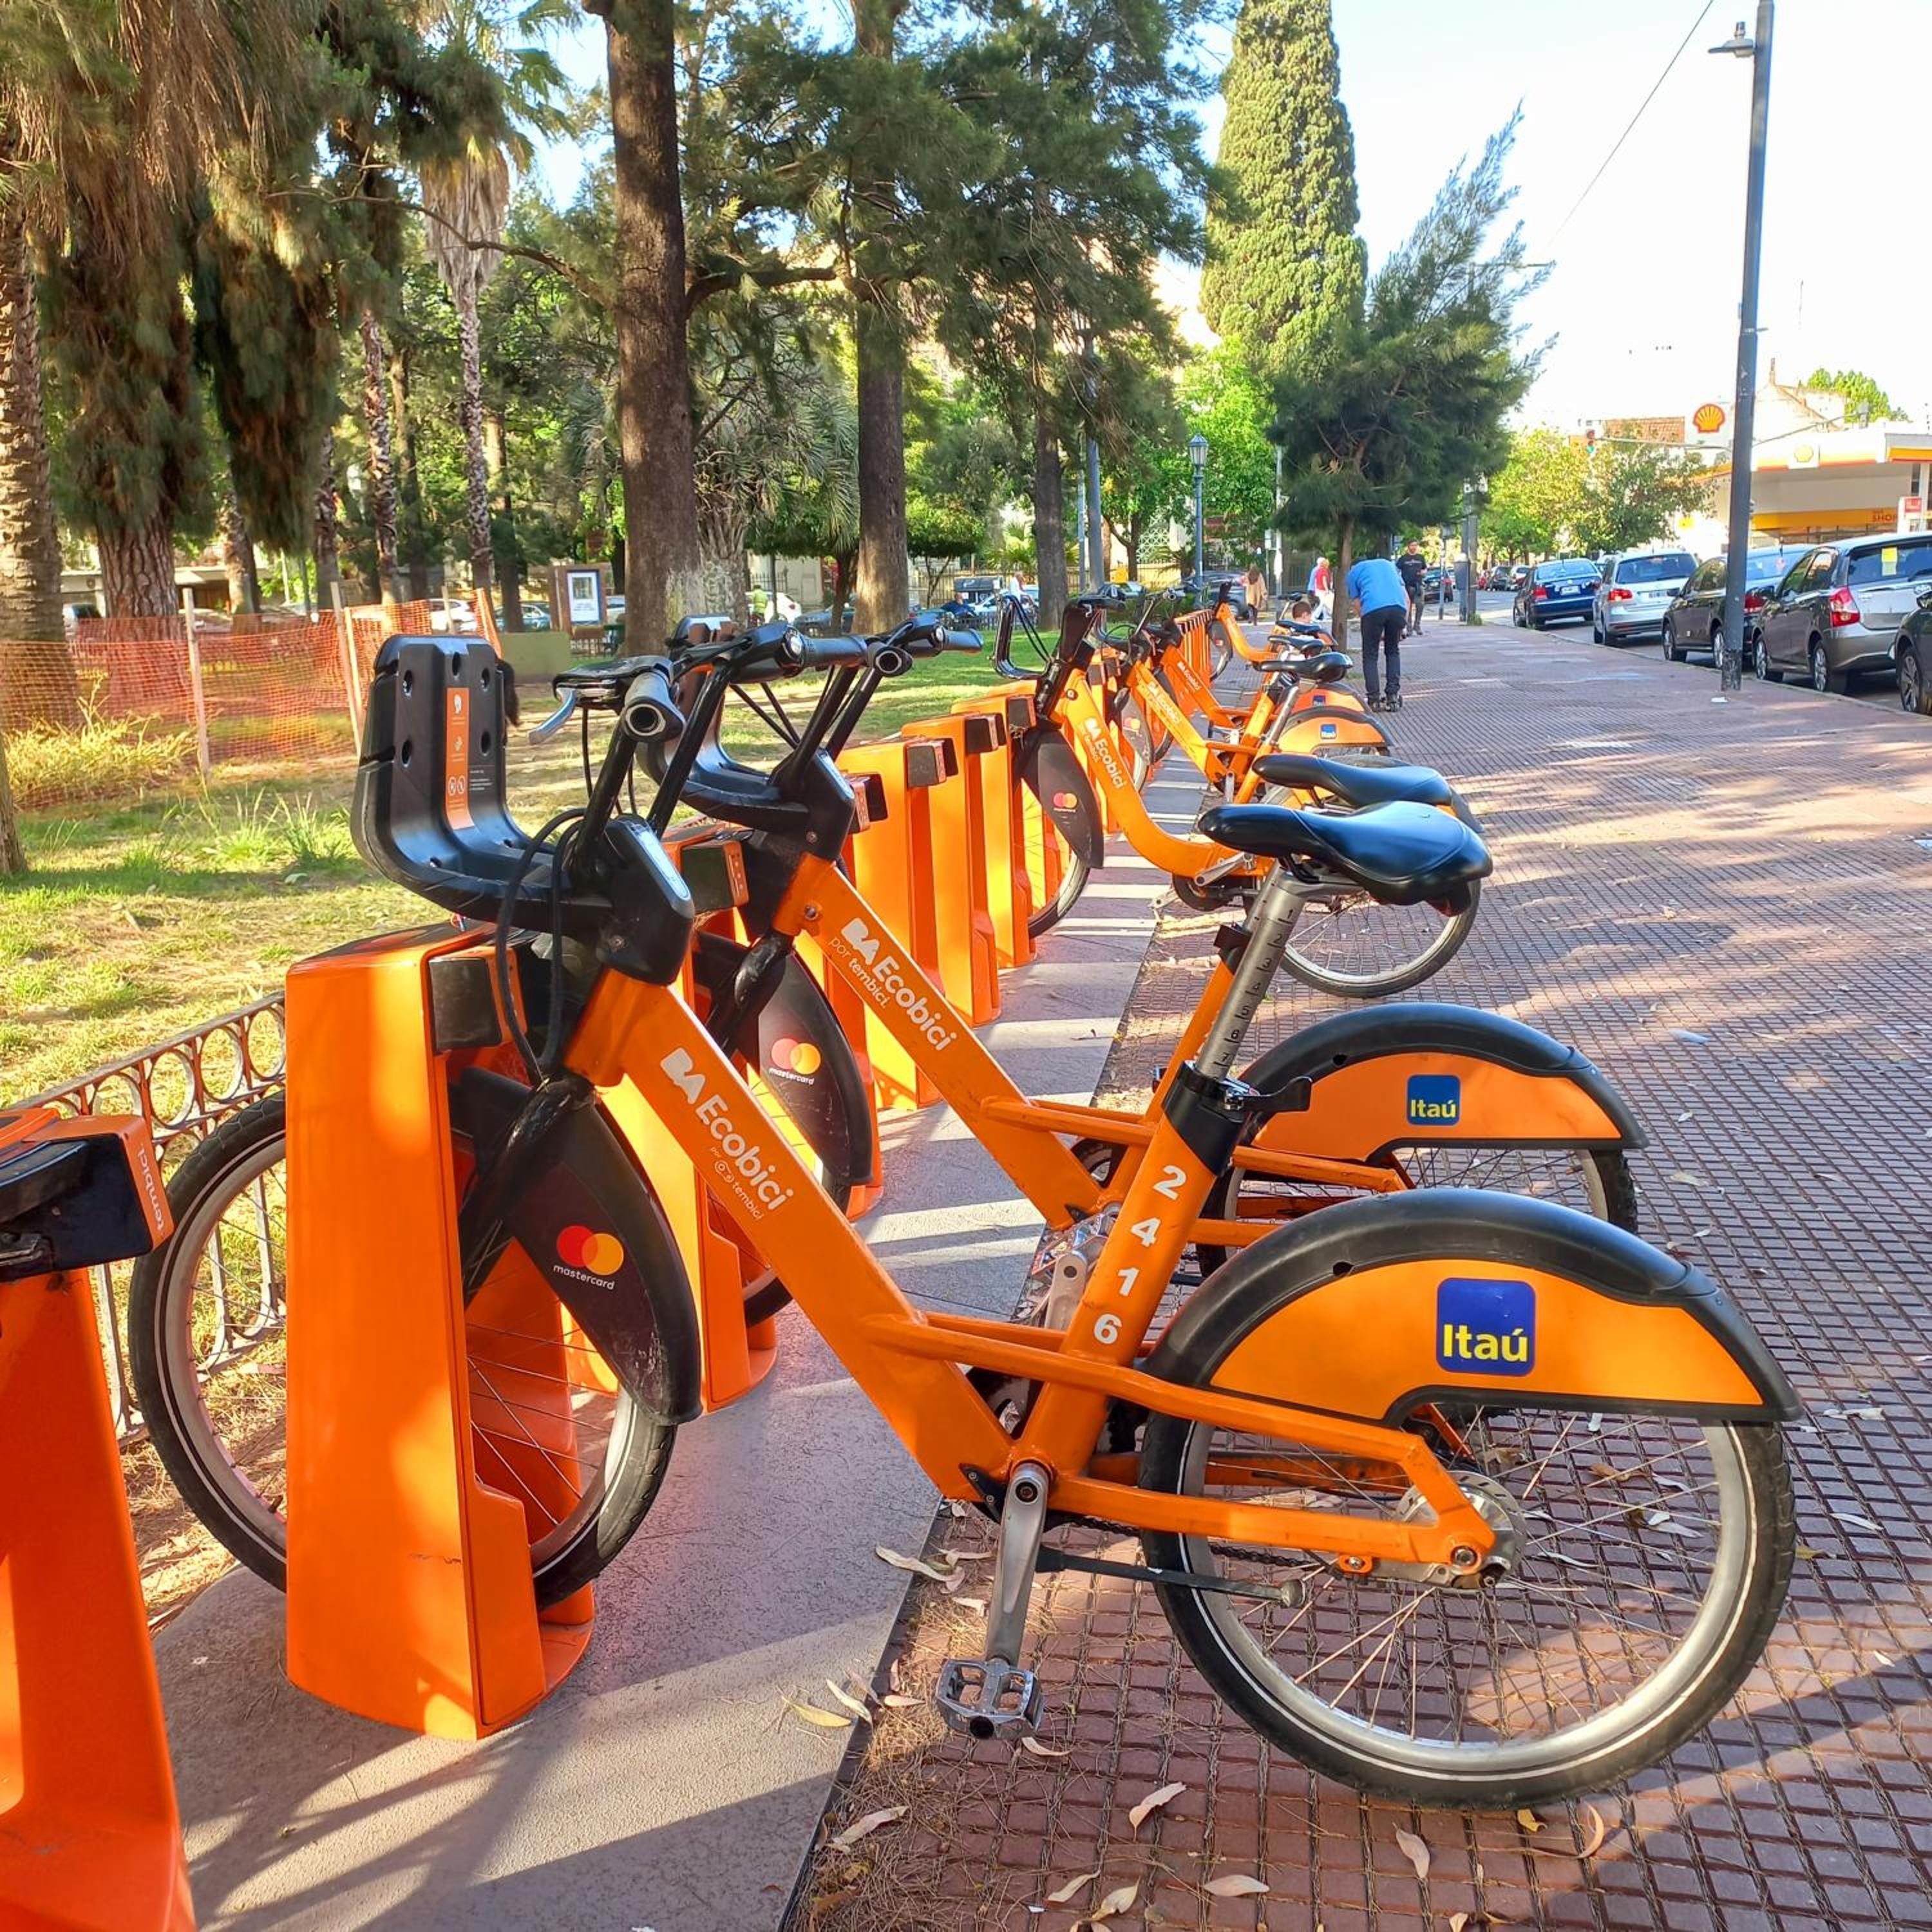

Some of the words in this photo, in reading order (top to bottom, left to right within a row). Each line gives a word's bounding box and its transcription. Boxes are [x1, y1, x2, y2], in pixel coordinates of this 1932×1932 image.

[1095, 737, 1128, 789] Ecobici
[828, 937, 851, 958] por
[840, 917, 880, 965] BA
[872, 955, 958, 1052] Ecobici
[768, 1067, 815, 1085] mastercard
[1410, 1099, 1457, 1118] Itaú
[660, 1047, 706, 1105] BA
[696, 1094, 794, 1210] Ecobici
[732, 1182, 764, 1220] tembici
[553, 1264, 615, 1291] mastercard
[1443, 1323, 1528, 1363] Itaú
